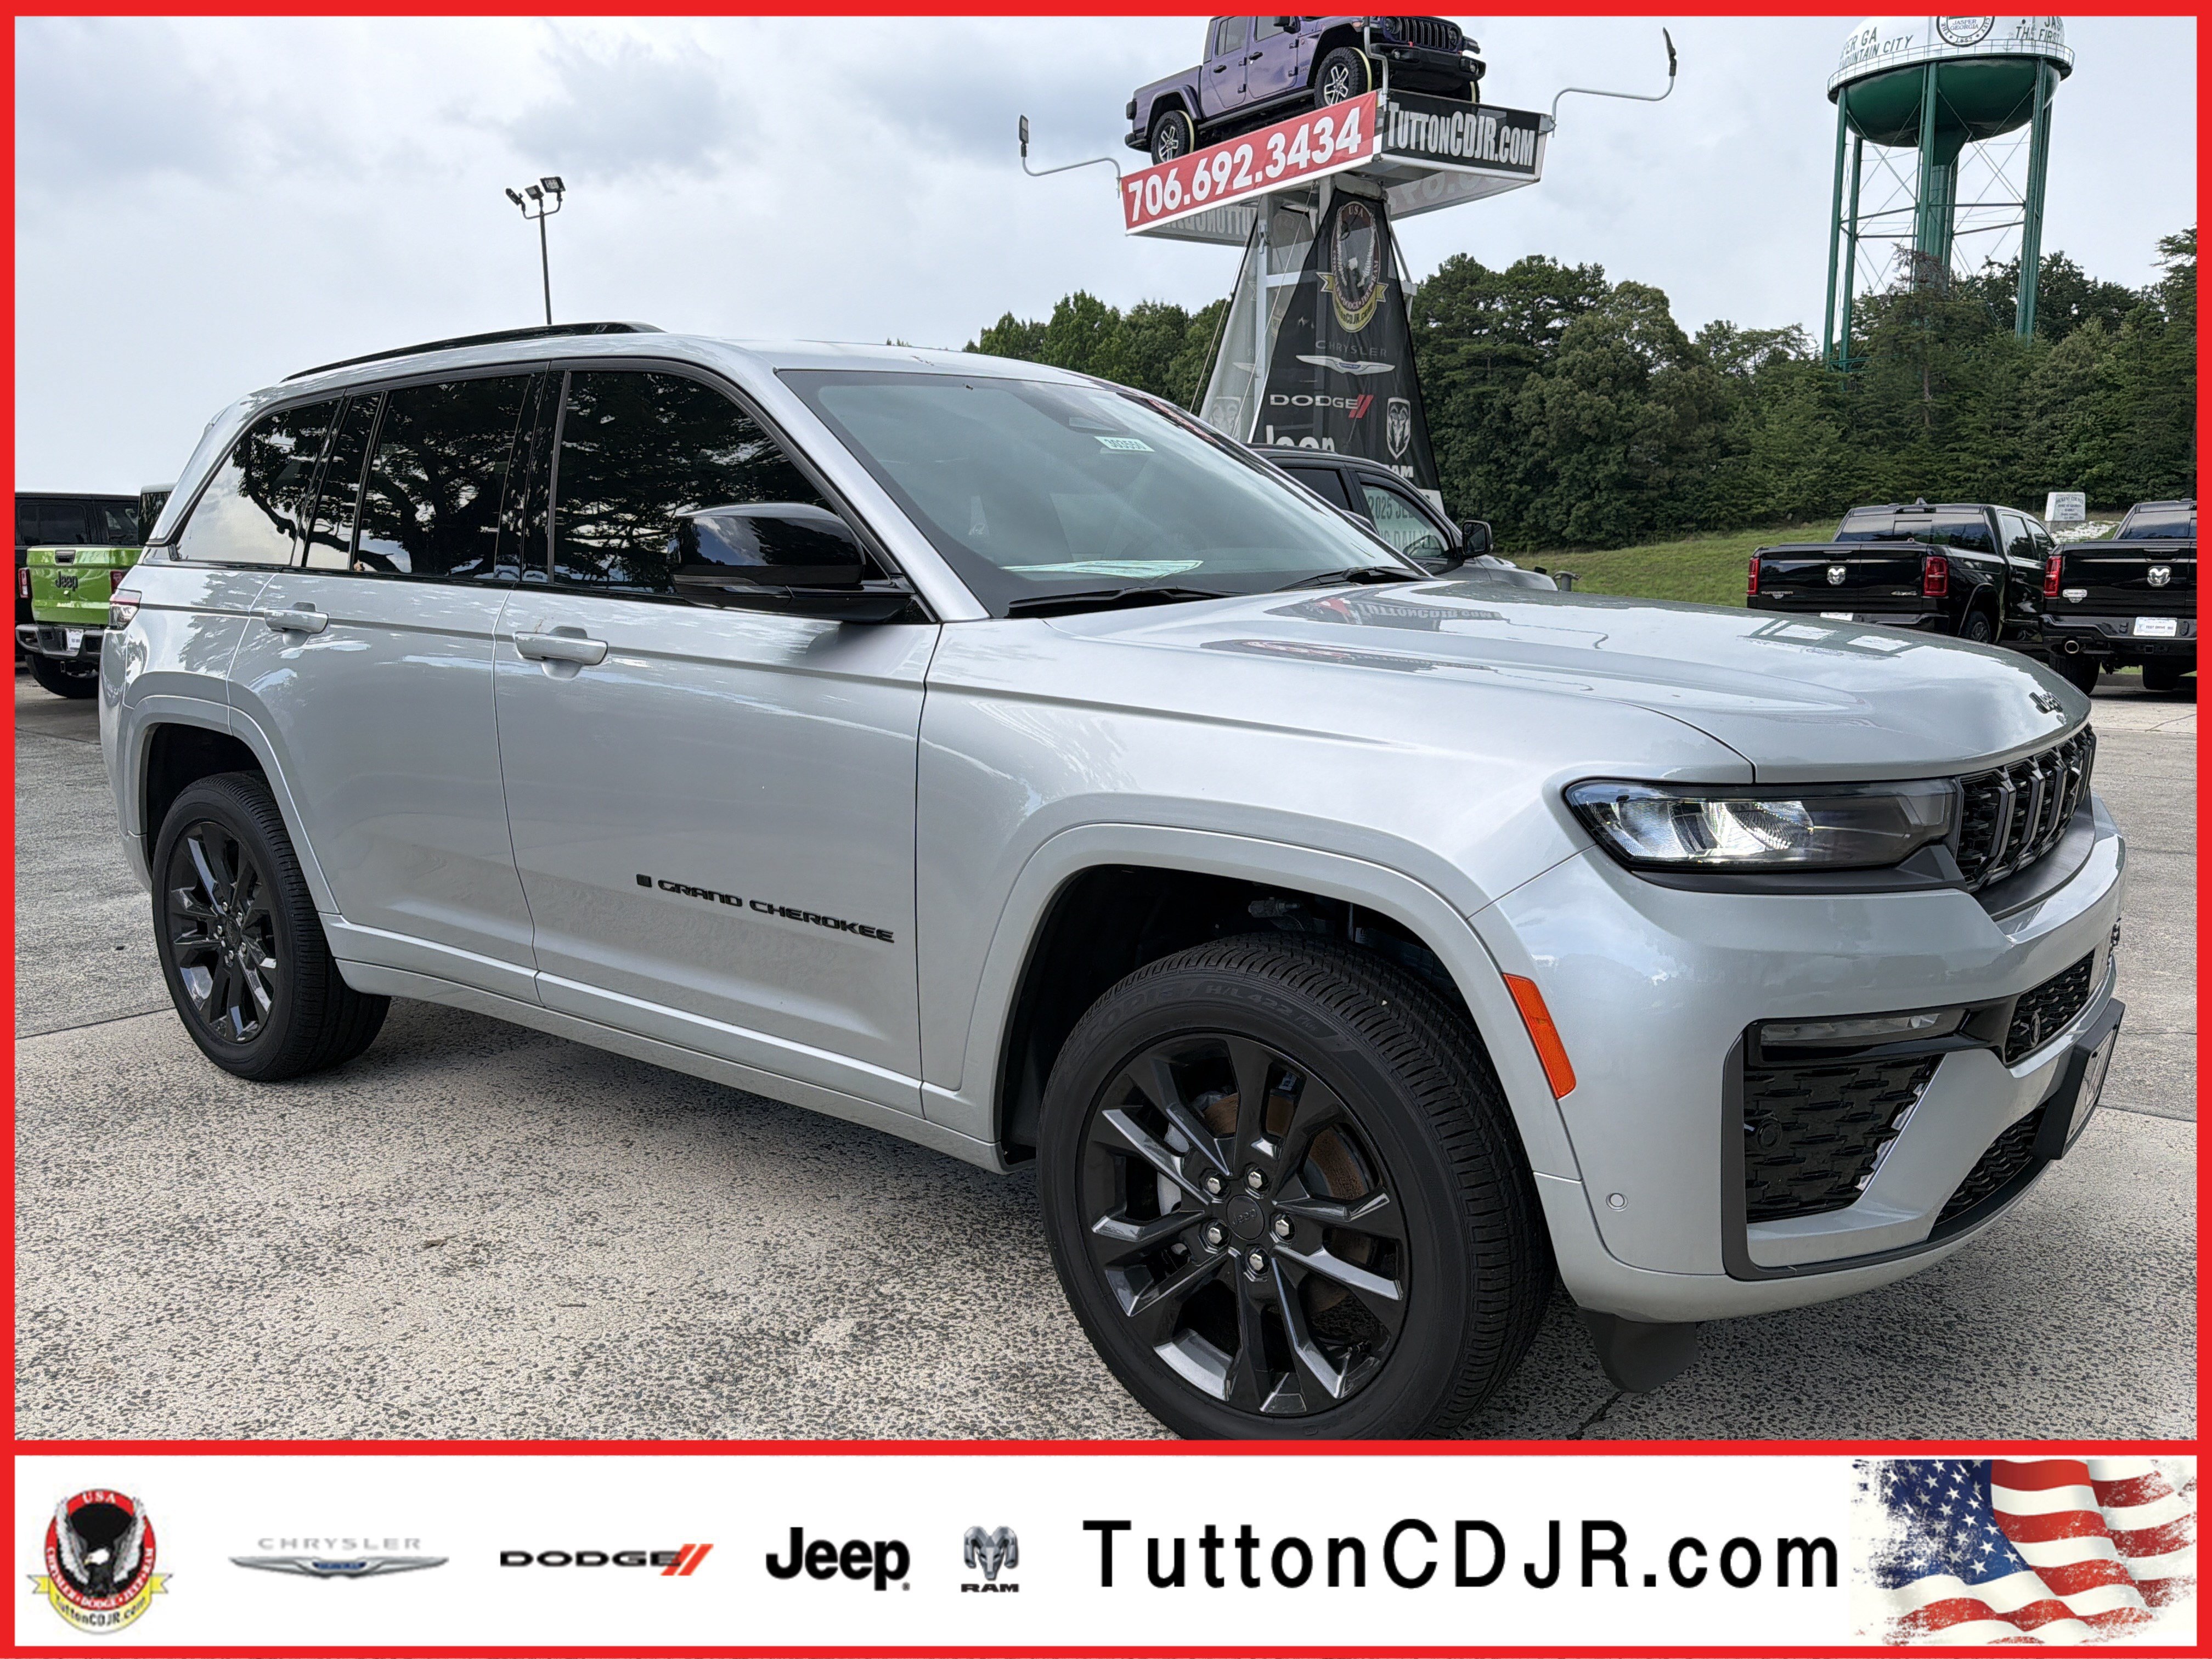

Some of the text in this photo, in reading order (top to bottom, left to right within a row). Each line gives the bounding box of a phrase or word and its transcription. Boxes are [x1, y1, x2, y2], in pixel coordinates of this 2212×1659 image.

[1861, 26, 1877, 46] GA
[1883, 35, 1914, 53] CITY
[2039, 28, 2060, 44] FIRST
[1128, 106, 1362, 222] 706.692.3434
[1348, 205, 1363, 218] USA
[1315, 340, 1387, 357] CHRYSLER
[1269, 394, 1358, 409] DODGE
[1368, 495, 1392, 520] 2025
[55, 571, 78, 591] Jeep
[658, 879, 895, 944] GRAND CHEROKEE
